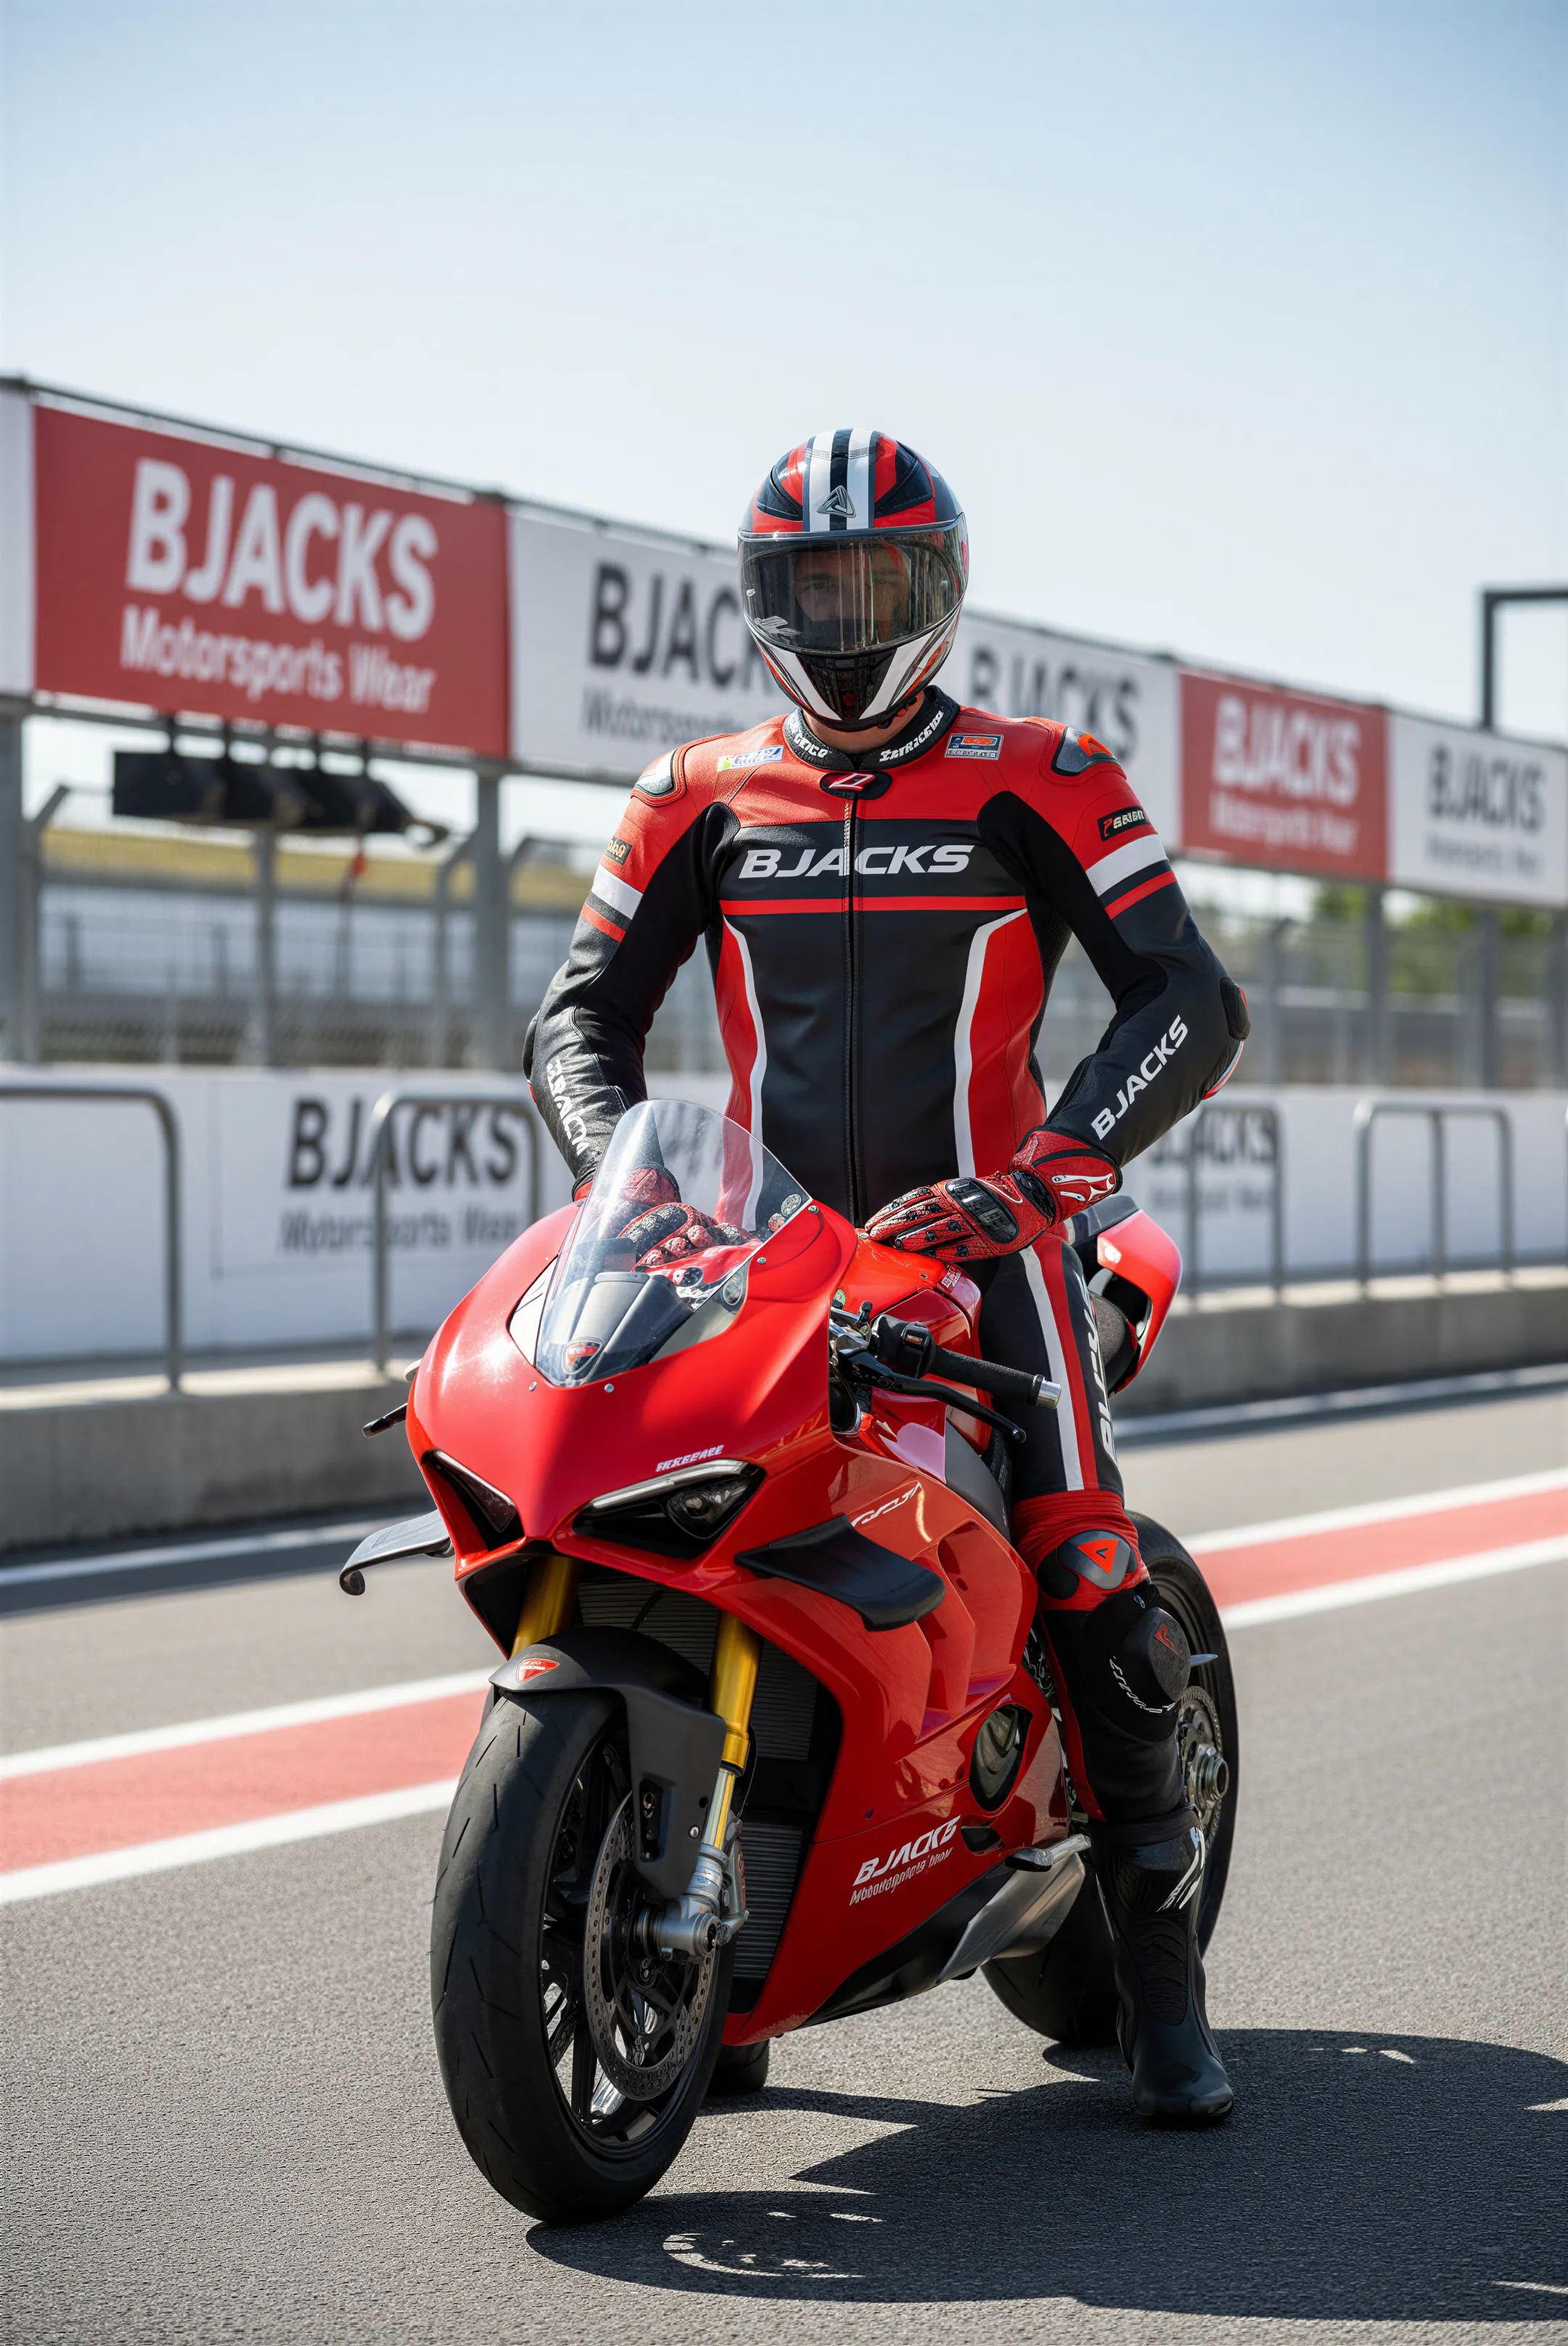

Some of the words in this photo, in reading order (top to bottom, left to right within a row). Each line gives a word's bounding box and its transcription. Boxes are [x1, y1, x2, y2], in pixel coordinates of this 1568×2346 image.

[126, 457, 438, 641] BJACKS
[121, 605, 343, 703] Motorsports
[348, 643, 436, 714] Wear
[589, 559, 771, 694] BJACK
[1213, 695, 1362, 804] BJACKS
[738, 844, 975, 880] BJACKS
[1090, 1015, 1188, 1140] BJACKS
[288, 1099, 518, 1188] BJACKS
